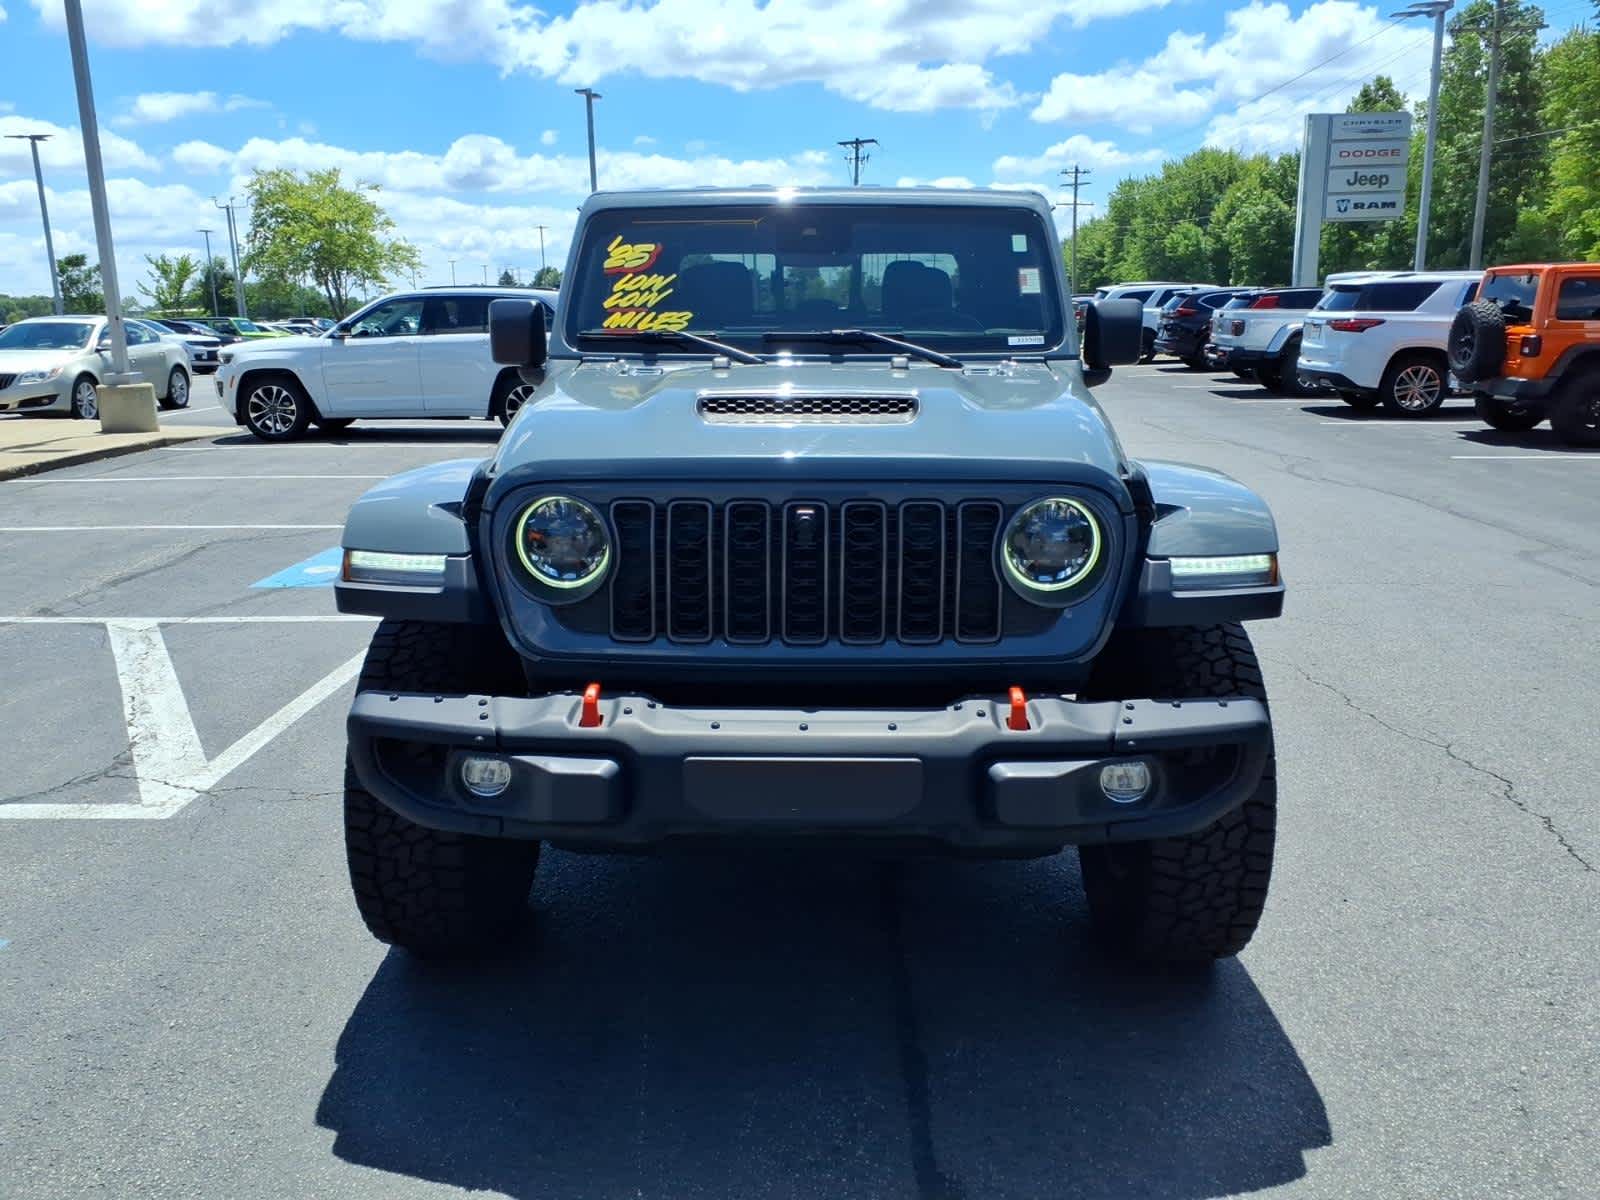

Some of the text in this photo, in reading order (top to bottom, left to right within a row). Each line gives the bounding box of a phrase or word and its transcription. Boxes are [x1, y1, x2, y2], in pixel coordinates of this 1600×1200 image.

[1339, 149, 1401, 158] DODGE
[1346, 171, 1389, 188] Jeep
[1353, 201, 1396, 210] RAM
[603, 312, 693, 332] MILES
